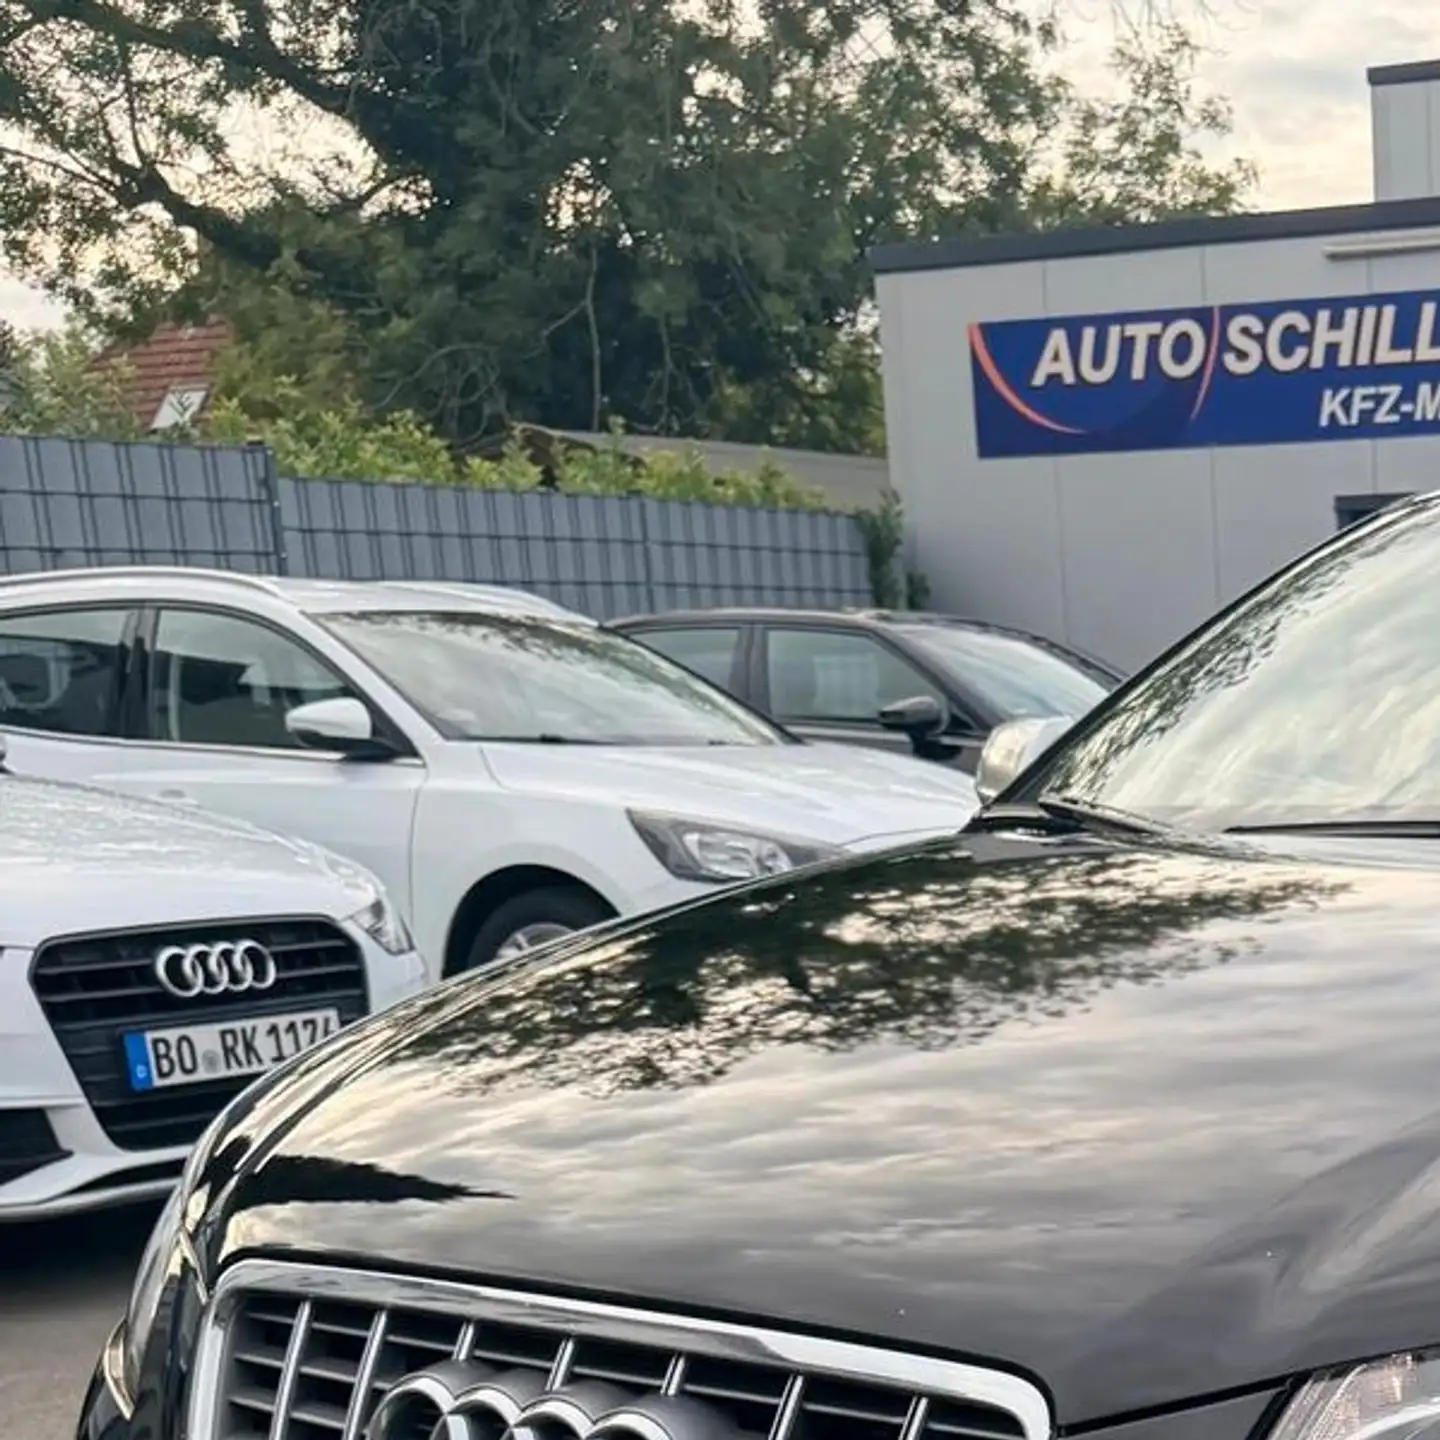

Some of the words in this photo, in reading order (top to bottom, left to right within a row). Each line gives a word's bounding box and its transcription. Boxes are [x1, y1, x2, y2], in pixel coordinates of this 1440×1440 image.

[1031, 319, 1206, 388] AUTO
[151, 1034, 199, 1079] BO
[219, 1025, 263, 1071] RK
